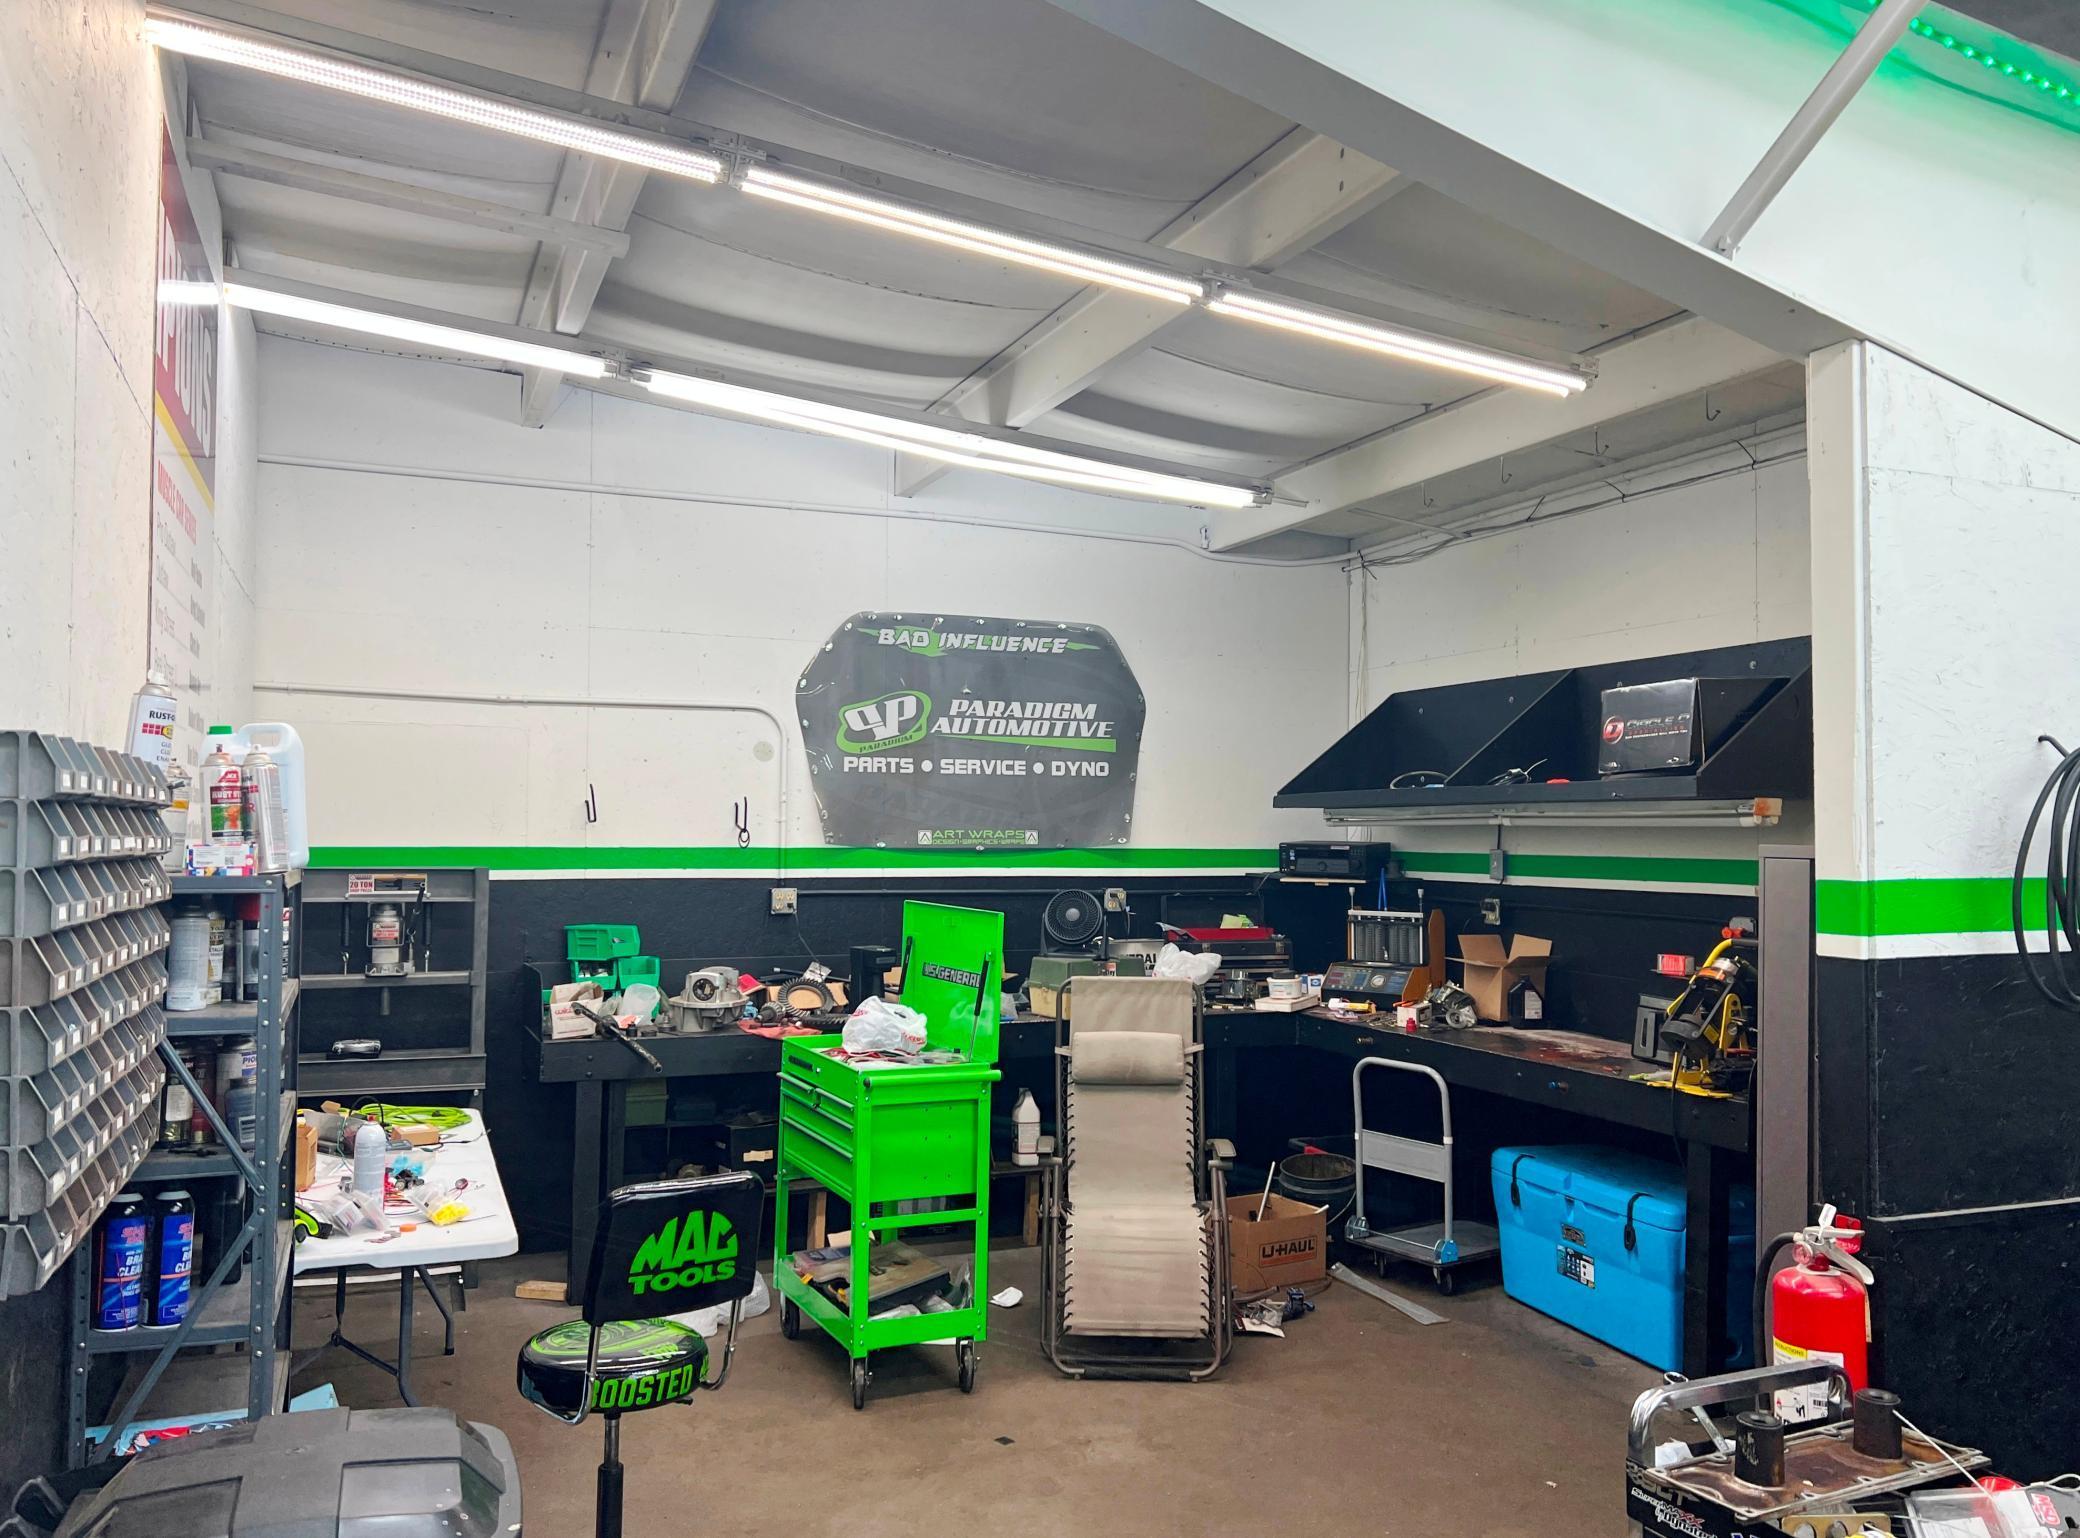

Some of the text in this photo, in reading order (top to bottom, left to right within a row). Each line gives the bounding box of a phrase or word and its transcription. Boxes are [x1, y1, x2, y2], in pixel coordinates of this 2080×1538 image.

[878, 628, 1070, 654] BAD INFLUENCE
[950, 699, 1098, 720] PARADIGM
[931, 717, 1115, 738] AUTOMOTIVE
[843, 756, 1110, 777] PARTS SERVICE DYNO
[932, 830, 1025, 839] ART WRAPS
[350, 881, 373, 889] 20 TON
[629, 1210, 739, 1273] MAC
[1262, 1238, 1315, 1258] U-HAUL
[628, 1260, 737, 1295] TOOLS
